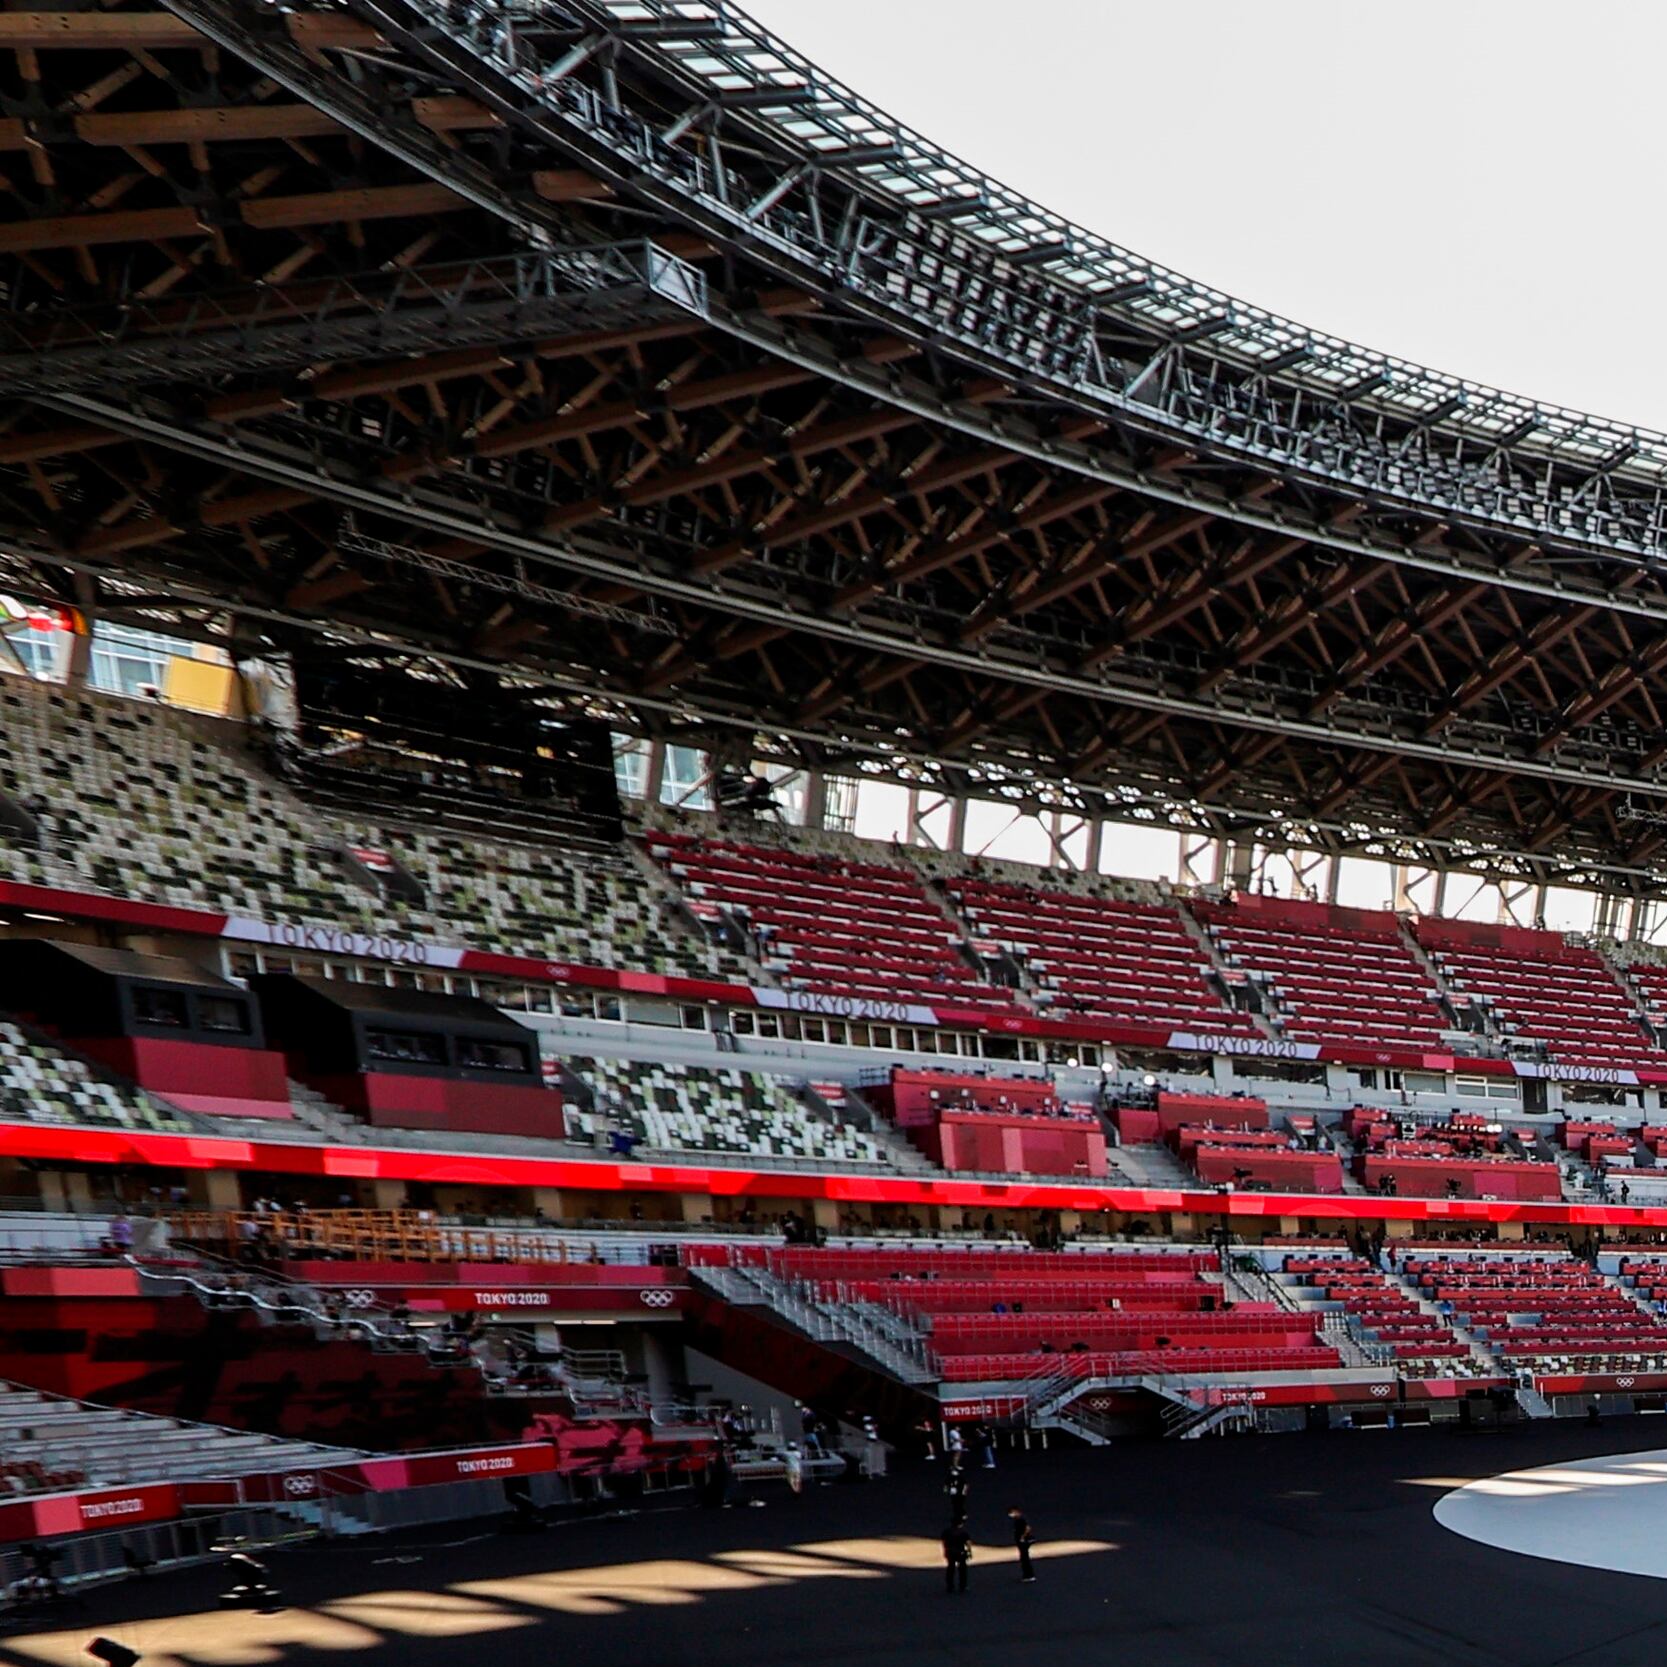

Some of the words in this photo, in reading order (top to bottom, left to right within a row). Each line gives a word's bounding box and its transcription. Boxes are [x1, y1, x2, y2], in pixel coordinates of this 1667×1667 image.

[263, 921, 354, 952] TOKYO
[363, 936, 425, 962] 2020
[783, 991, 852, 1016] TOKYO
[857, 999, 909, 1021] 2020
[1193, 1035, 1251, 1052] TOKYO
[1258, 1041, 1297, 1057] 2020
[1535, 1063, 1581, 1080] TOKYO
[1586, 1067, 1619, 1083] 2020
[475, 1293, 517, 1305] TOKYO
[518, 1293, 549, 1305] 2020
[944, 1407, 970, 1416] TOKYO
[457, 1460, 488, 1472] TOKYO
[489, 1457, 515, 1470] 2020
[80, 1501, 113, 1518] TOKYO
[114, 1498, 144, 1514] 2020
